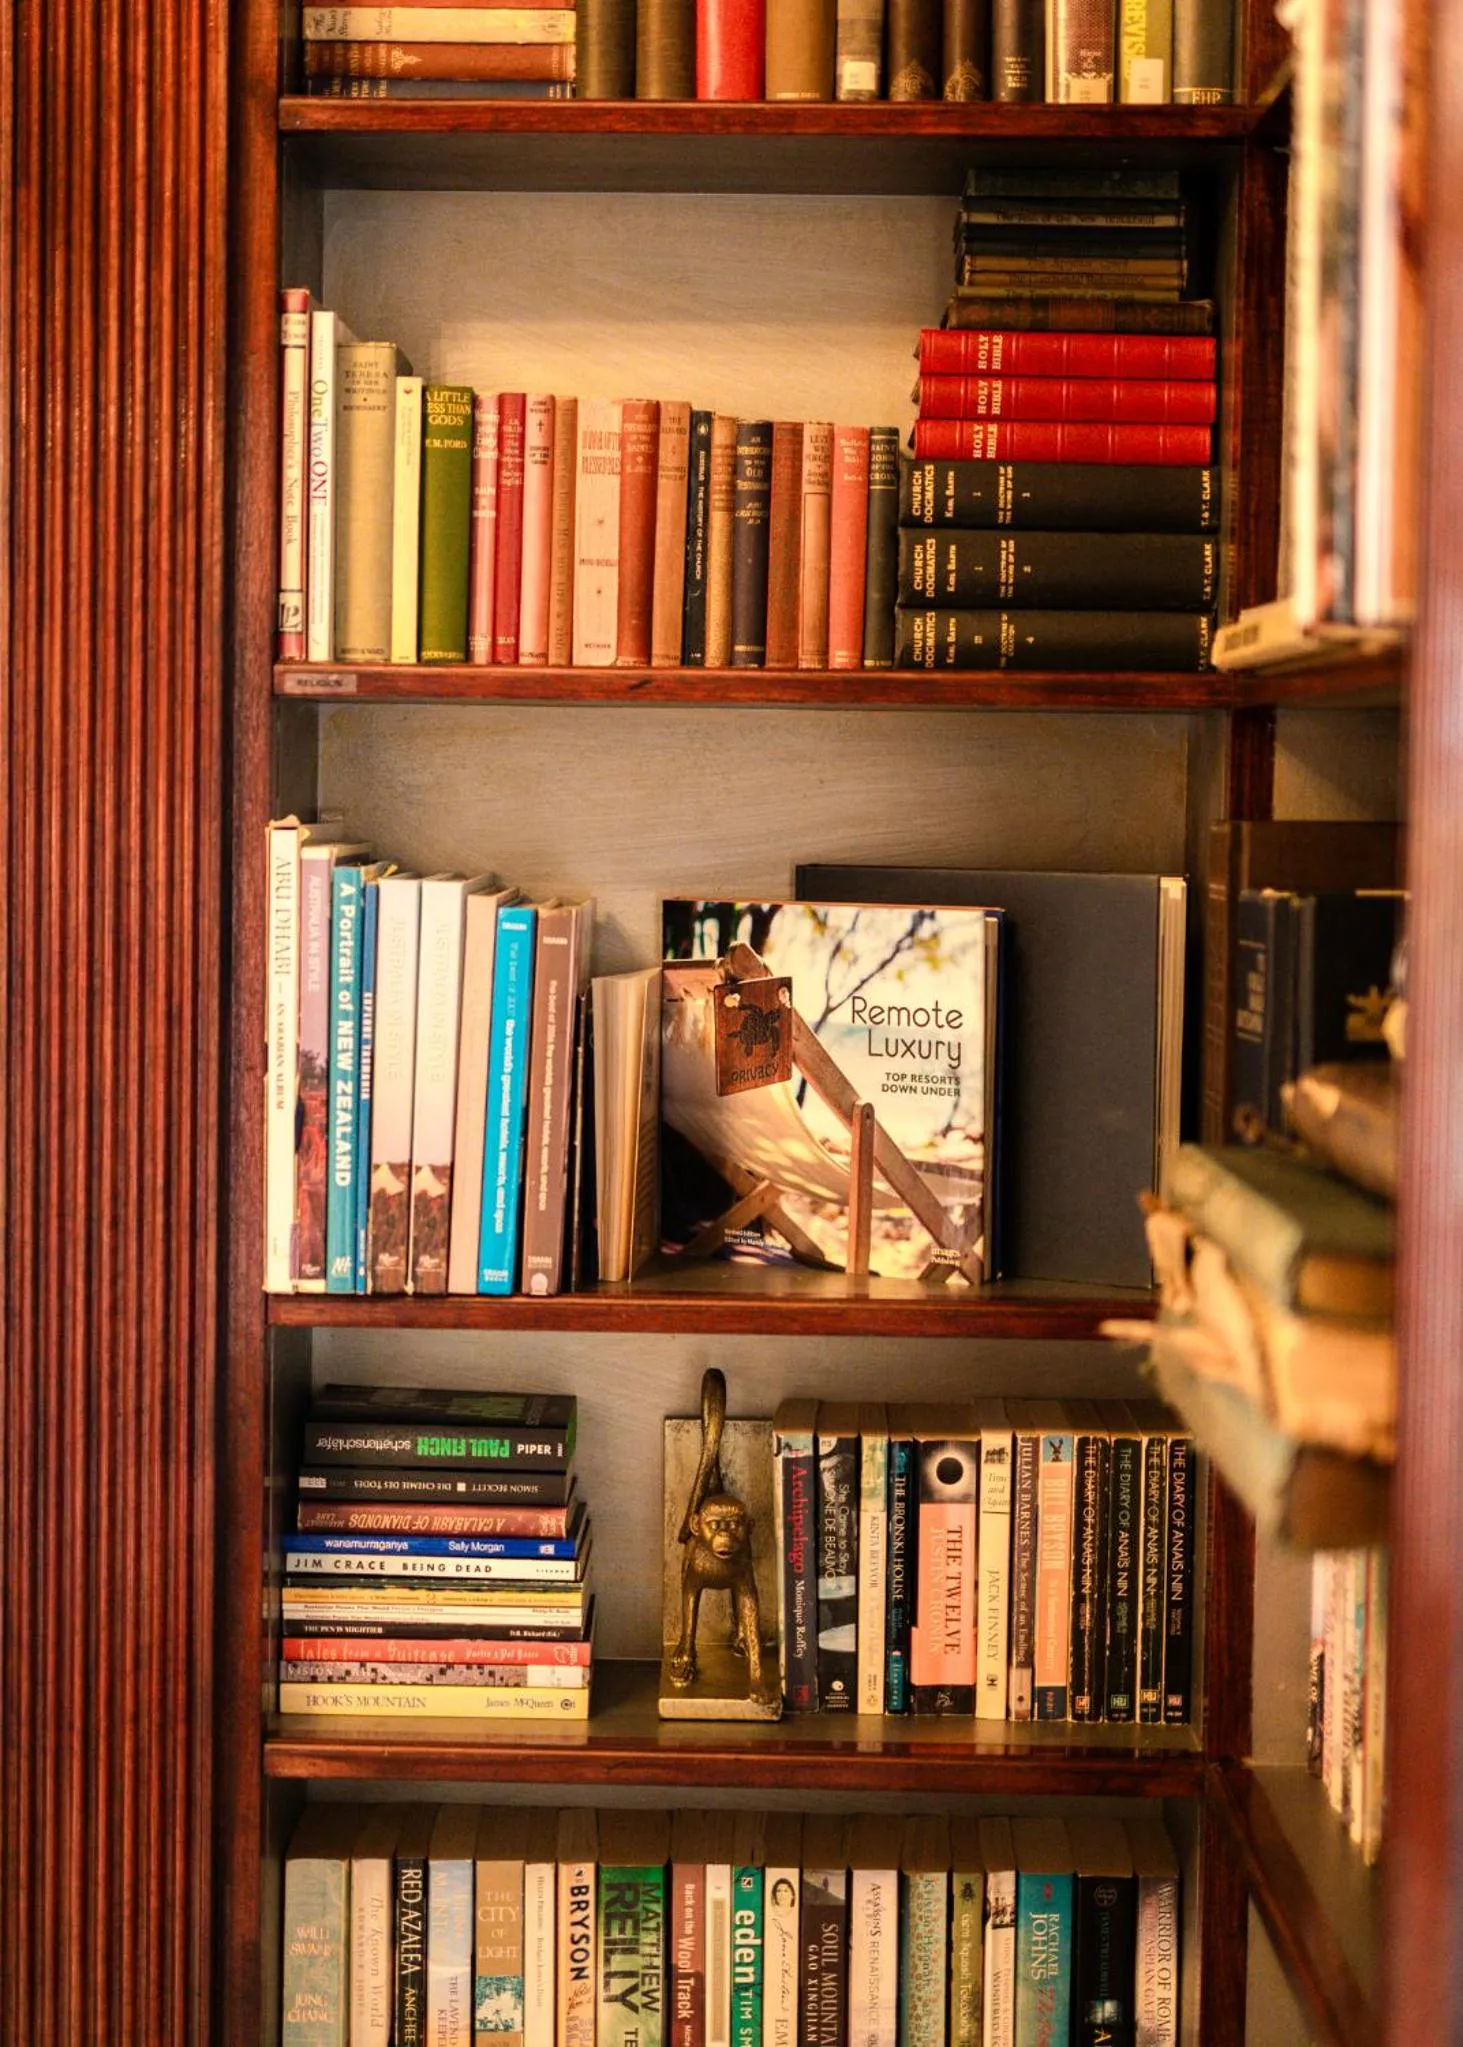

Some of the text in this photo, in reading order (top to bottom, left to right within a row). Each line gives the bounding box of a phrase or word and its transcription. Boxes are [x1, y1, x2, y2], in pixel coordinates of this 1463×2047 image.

[977, 334, 990, 370] HOLY
[992, 334, 1003, 370] BIBLE
[434, 391, 471, 402] LITTLE
[448, 403, 471, 415] THAN
[977, 379, 989, 415] HOLY
[991, 380, 1002, 416] BIBLE
[428, 415, 465, 426] GODS
[972, 423, 984, 459] HOLY
[986, 423, 998, 460] BIBLE
[912, 470, 922, 517] CHURCH
[924, 464, 935, 524] DOGMATICS
[1201, 470, 1210, 501] CLARK
[913, 544, 923, 591] CHURCH
[925, 538, 936, 598] DOGMATICS
[1203, 544, 1212, 575] CLARK
[913, 617, 923, 662] CHURCH
[925, 611, 936, 669] DOGMATICS
[1199, 616, 1208, 648] CLARK
[275, 856, 293, 974] ABU DHABI
[851, 995, 964, 1030] Remote
[334, 882, 356, 1187] A Portrait of NEW ZEALAND
[868, 1028, 961, 1070] Luxury
[881, 1083, 961, 1097] DOWN UNDER
[885, 1072, 961, 1086] TOP RESORTS
[315, 1436, 511, 1458] PAUL FINCH schattenschläfer
[517, 1443, 551, 1455] PIPER
[1085, 1444, 1097, 1466] THE
[1120, 1447, 1132, 1472] THE
[1173, 1445, 1186, 1469] THE
[354, 1479, 382, 1489] TODES
[383, 1480, 400, 1490] DES
[401, 1481, 436, 1490] CHEMIE
[472, 1482, 508, 1492] BECKETT
[894, 1477, 906, 1496] THE
[1084, 1470, 1096, 1506] DIARY
[1119, 1473, 1131, 1508] DIARY
[1172, 1471, 1185, 1508] DIARY
[348, 1513, 413, 1530] DIAMONDS
[414, 1515, 431, 1531] OF
[824, 1517, 835, 1533] DE
[836, 1484, 849, 1575] She Came to Stay
[868, 1515, 880, 1547] KINTA
[892, 1501, 905, 1554] BRONSKI
[1042, 1478, 1066, 1570] BILL BRYSON
[1084, 1507, 1096, 1524] OF
[1119, 1509, 1131, 1528] OF
[1146, 1444, 1160, 1593] THE DIARY OF NIN
[1172, 1509, 1185, 1528] OF
[294, 1558, 493, 1573] JIM CRACE BEING DEAD
[448, 1541, 505, 1554] Sally Morgan
[787, 1465, 809, 1659] Archipelago Monique Roffey
[1015, 1441, 1033, 1662] JULIAN BARNES The Sense of an Ending
[892, 1558, 904, 1601] HOUSE
[944, 1525, 963, 1656] THE TWELVE
[1116, 1571, 1129, 1597] NIN
[1171, 1573, 1184, 1601] NIN
[986, 1570, 1001, 1661] JACK FINNEY
[306, 1693, 427, 1708] HOOK'S MOUNTAIN
[478, 1905, 520, 1923] CITY
[961, 1913, 972, 1938] Gem
[491, 1927, 506, 1940] OF
[570, 1885, 590, 1981] BRYSON
[603, 1882, 640, 2016] REILLY
[640, 1882, 661, 2014] MATTHEW
[820, 1922, 839, 1967] SOUL
[1028, 1911, 1047, 1981] JOHNS
[1047, 1913, 1060, 1980] RACHAEL
[369, 1928, 383, 1977] Known
[400, 1868, 422, 2043] RED AZALEA ANCHEE
[478, 1945, 519, 1959] LIGHT
[677, 1883, 696, 2020] Back on the Wool Track
[734, 1910, 762, 2020] eden TIM
[959, 1940, 972, 1980] Squash
[1156, 1882, 1173, 2042] WARRIOR OF ROME
[806, 1944, 819, 2042] GAO XINGJIAN
[868, 1941, 880, 2027] RENAISSANCE
[369, 1985, 384, 2029] World
